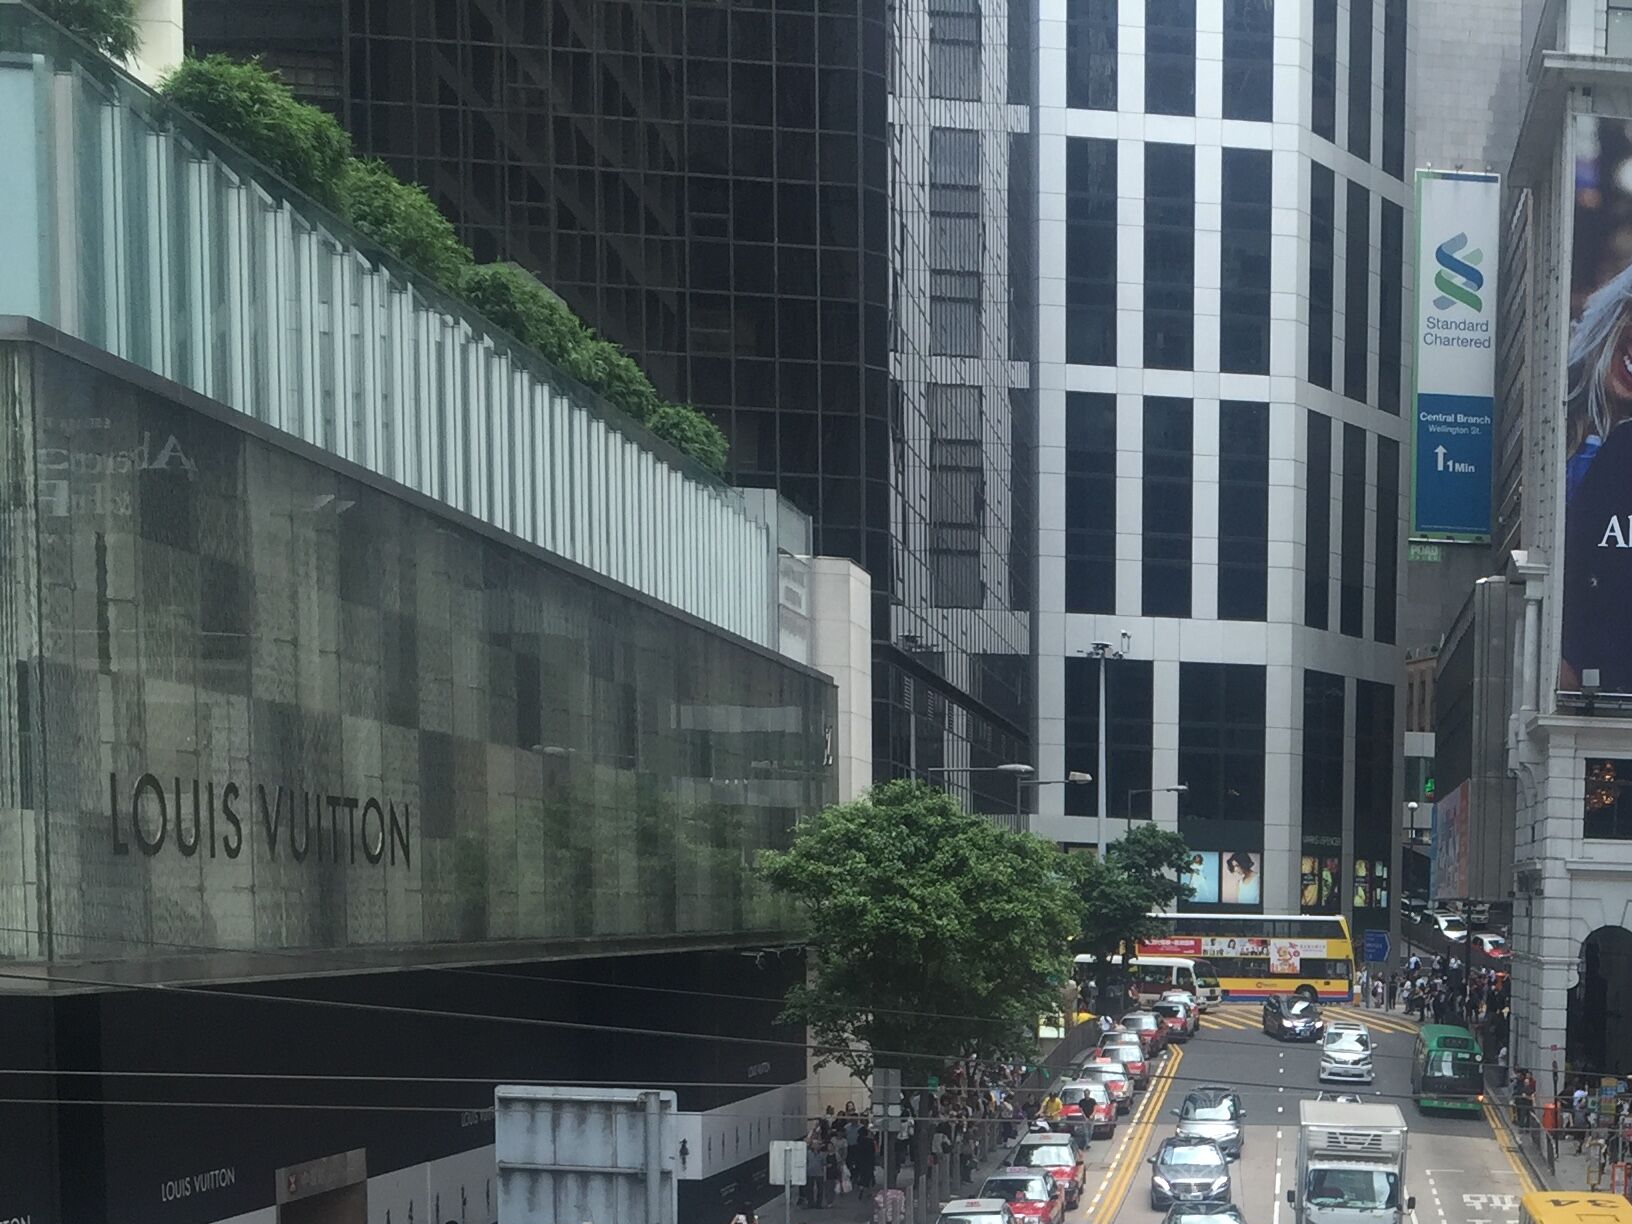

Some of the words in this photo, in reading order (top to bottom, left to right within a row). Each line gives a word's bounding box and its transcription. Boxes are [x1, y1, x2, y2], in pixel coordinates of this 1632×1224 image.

[1427, 317, 1489, 332] Standard
[1424, 333, 1491, 349] Chartered
[1420, 412, 1455, 422] Central
[1457, 414, 1491, 424] Branch
[1429, 424, 1469, 435] Wellington
[110, 772, 243, 859] LOUIS
[258, 783, 411, 872] VUITTON
[161, 1177, 191, 1202] LOUIS
[193, 1167, 235, 1193] VUITTON
